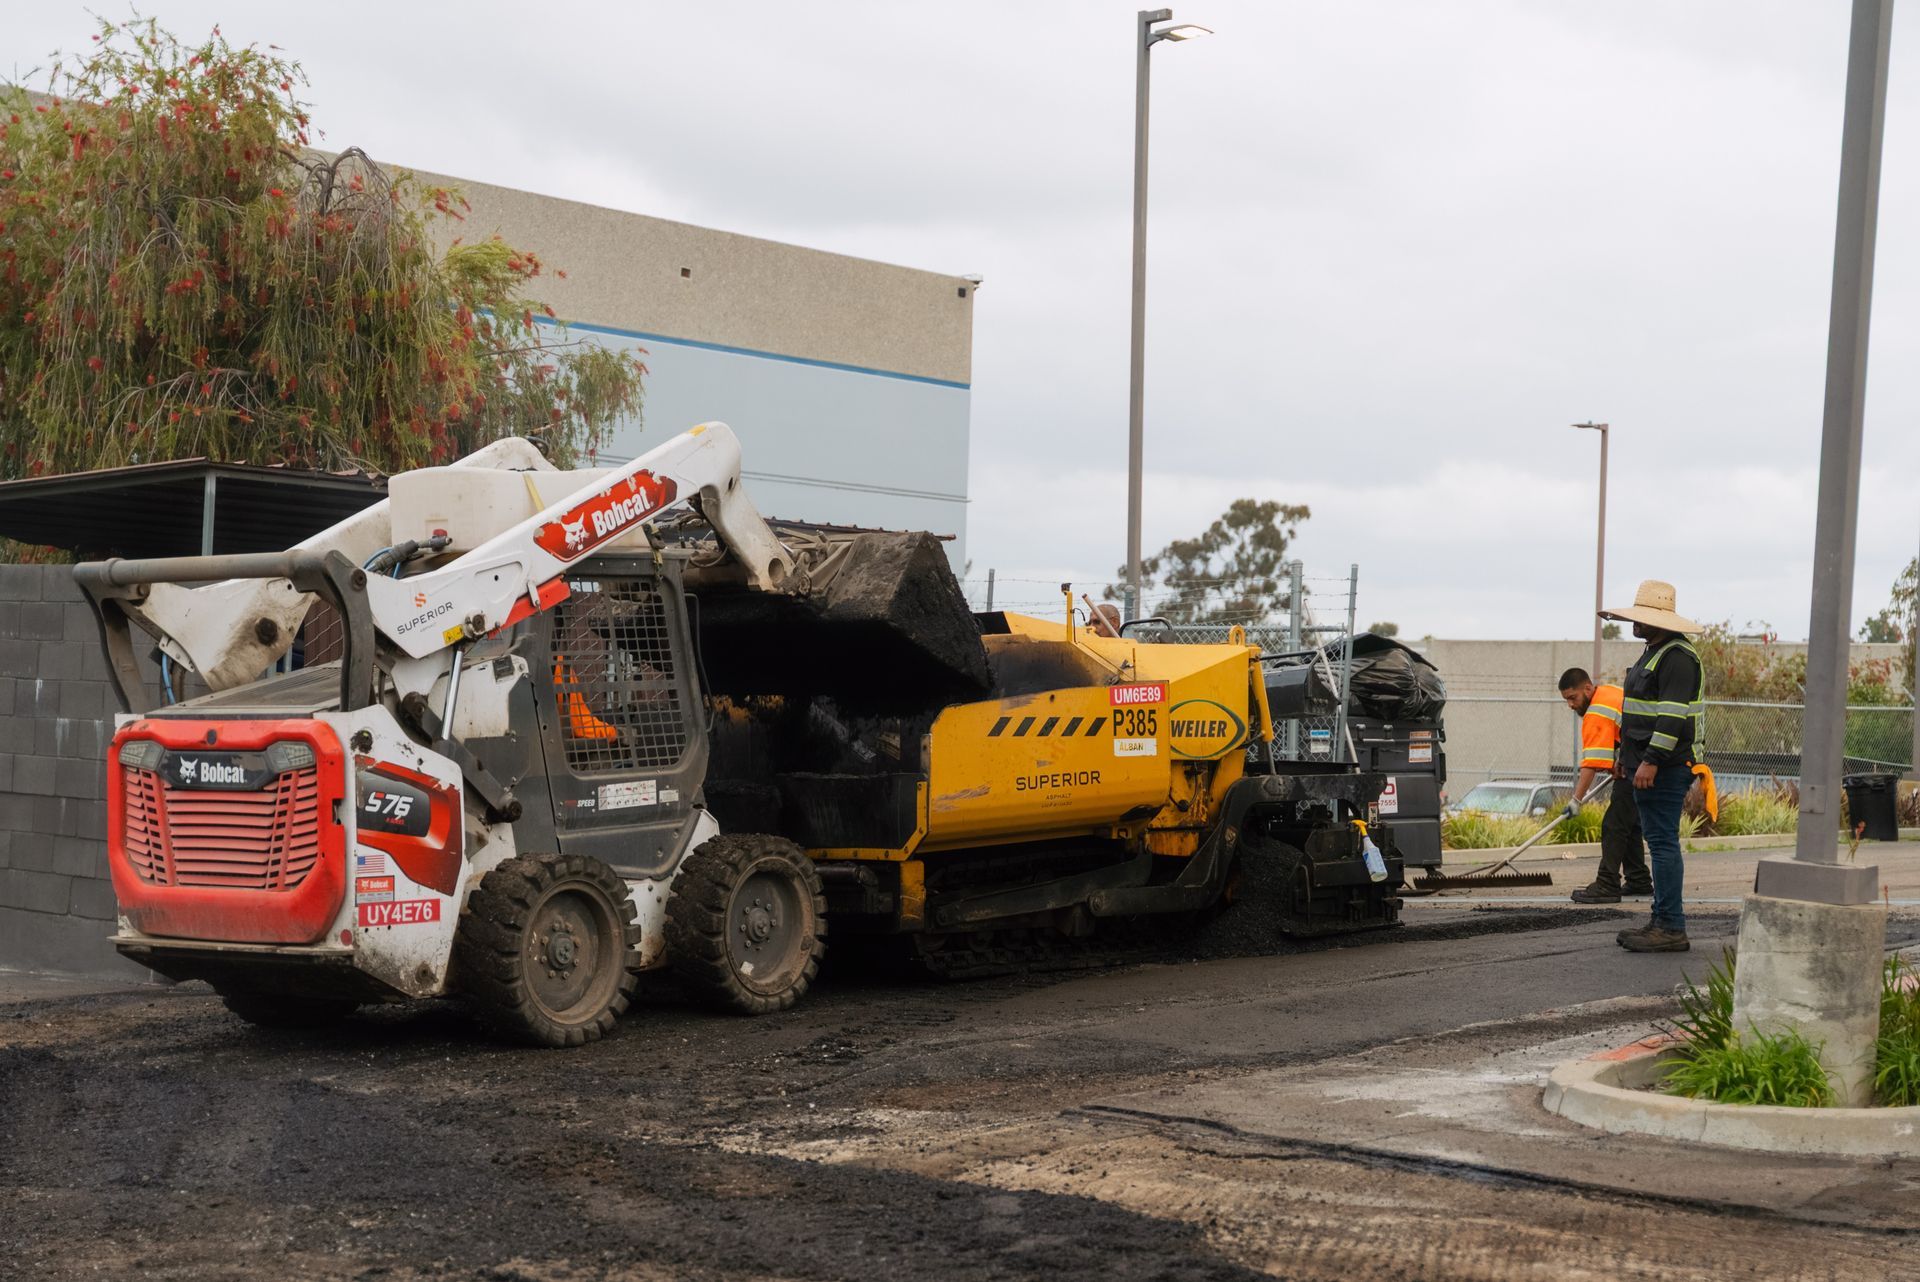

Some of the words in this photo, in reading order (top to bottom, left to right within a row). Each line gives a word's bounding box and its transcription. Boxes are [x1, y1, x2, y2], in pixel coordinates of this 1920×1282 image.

[591, 486, 651, 538] Bobcat
[396, 601, 454, 635] SUPERIOR
[1114, 686, 1161, 704] UM6E89
[1113, 709, 1158, 736] P385
[1170, 720, 1228, 738] WEILER
[200, 762, 245, 783] Bobcat
[1016, 770, 1101, 791] SUPERIOR
[365, 791, 414, 819] S76
[367, 902, 433, 924] UY4E76
